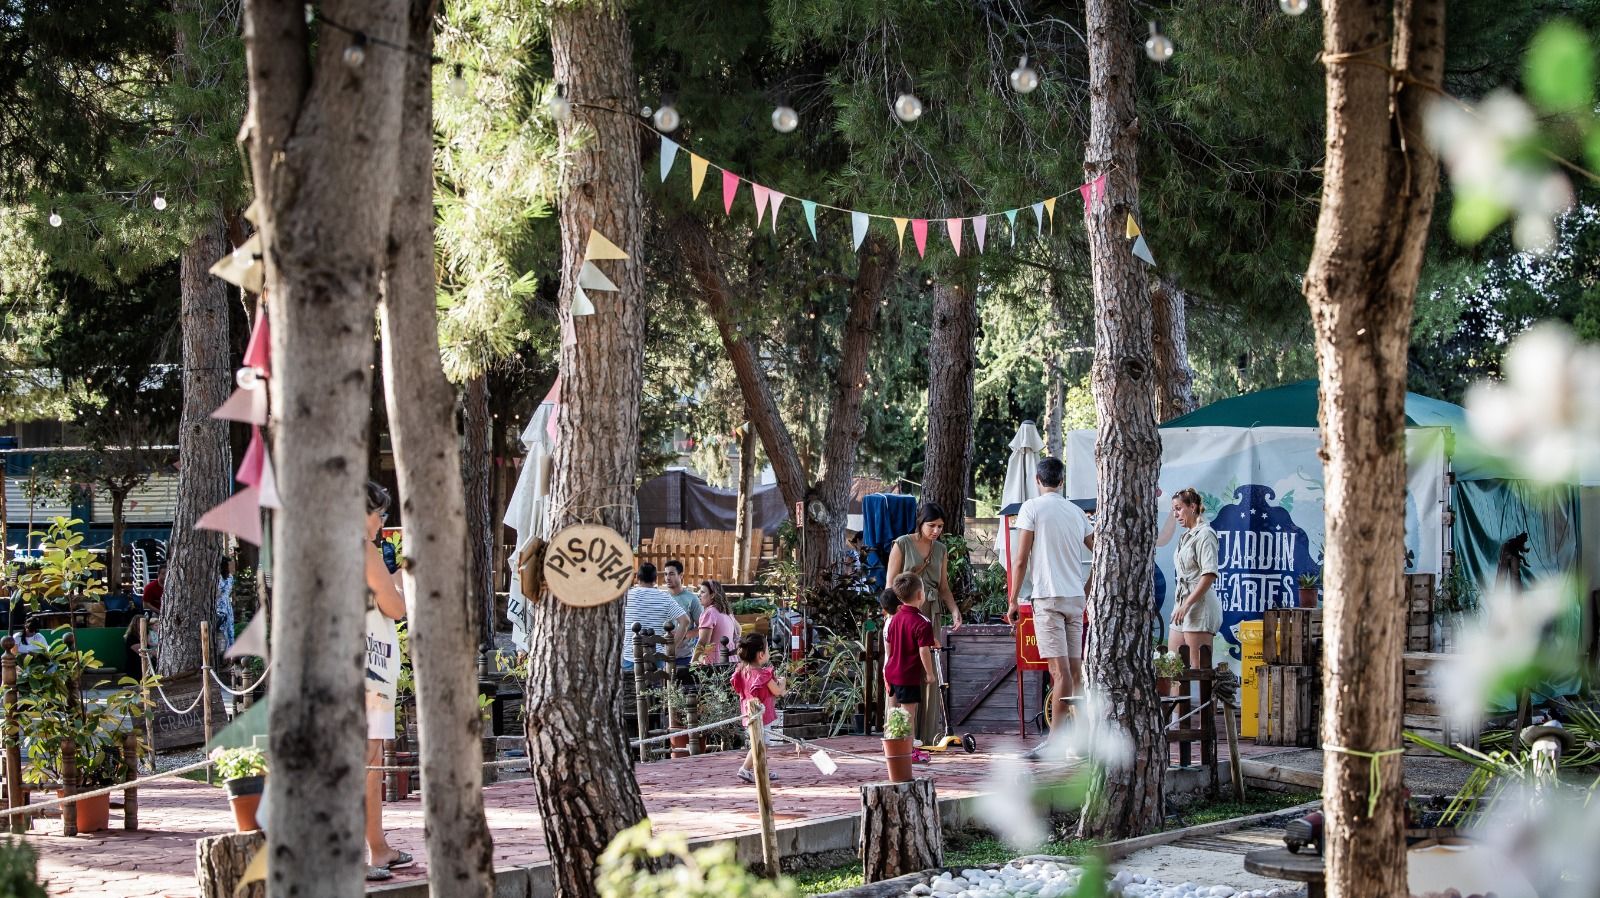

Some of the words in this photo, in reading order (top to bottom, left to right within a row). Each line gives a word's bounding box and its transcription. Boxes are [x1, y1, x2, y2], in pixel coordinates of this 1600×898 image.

[545, 537, 633, 590] PISOTEA
[1215, 572, 1228, 591] DE
[1228, 573, 1295, 613] ARTES
